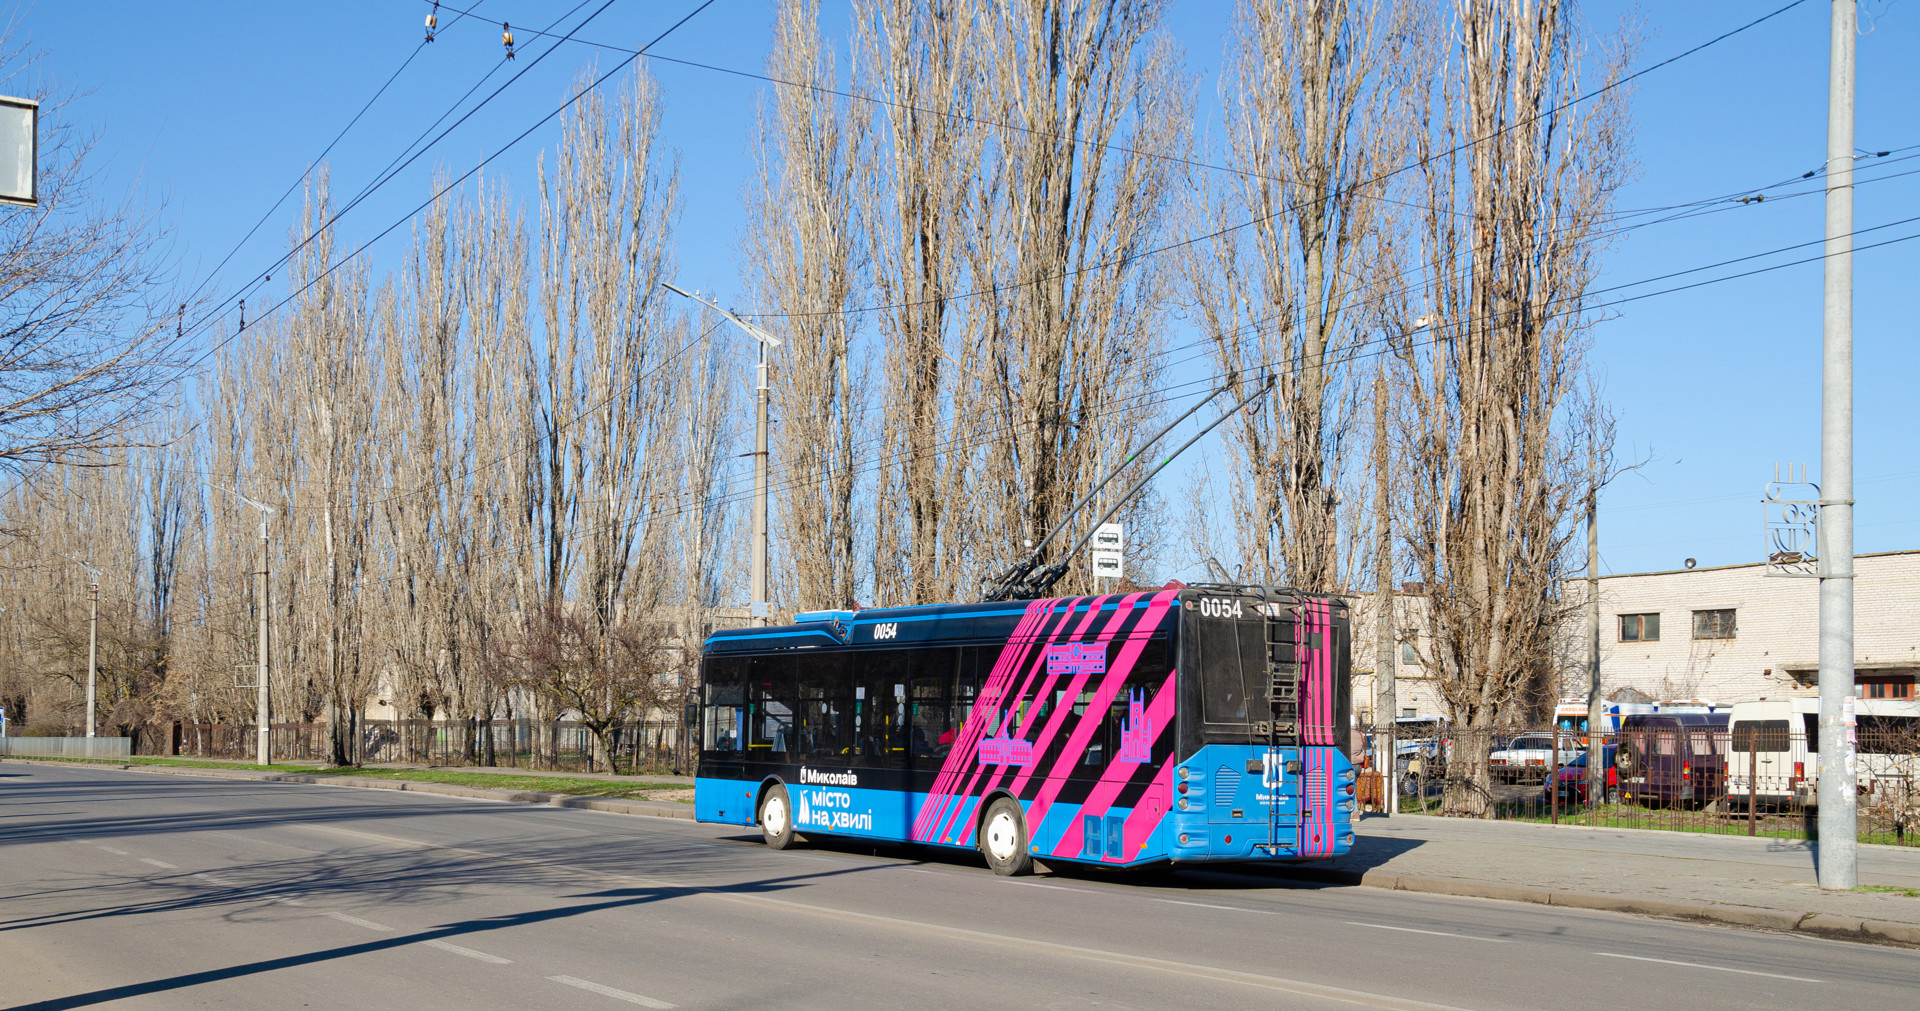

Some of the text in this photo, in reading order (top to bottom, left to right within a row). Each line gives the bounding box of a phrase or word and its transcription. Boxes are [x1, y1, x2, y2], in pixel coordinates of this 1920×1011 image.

[1200, 597, 1242, 618] 0054
[873, 622, 898, 640] 0054
[807, 768, 858, 786] Миколаїв
[811, 808, 872, 831] на хвилі
